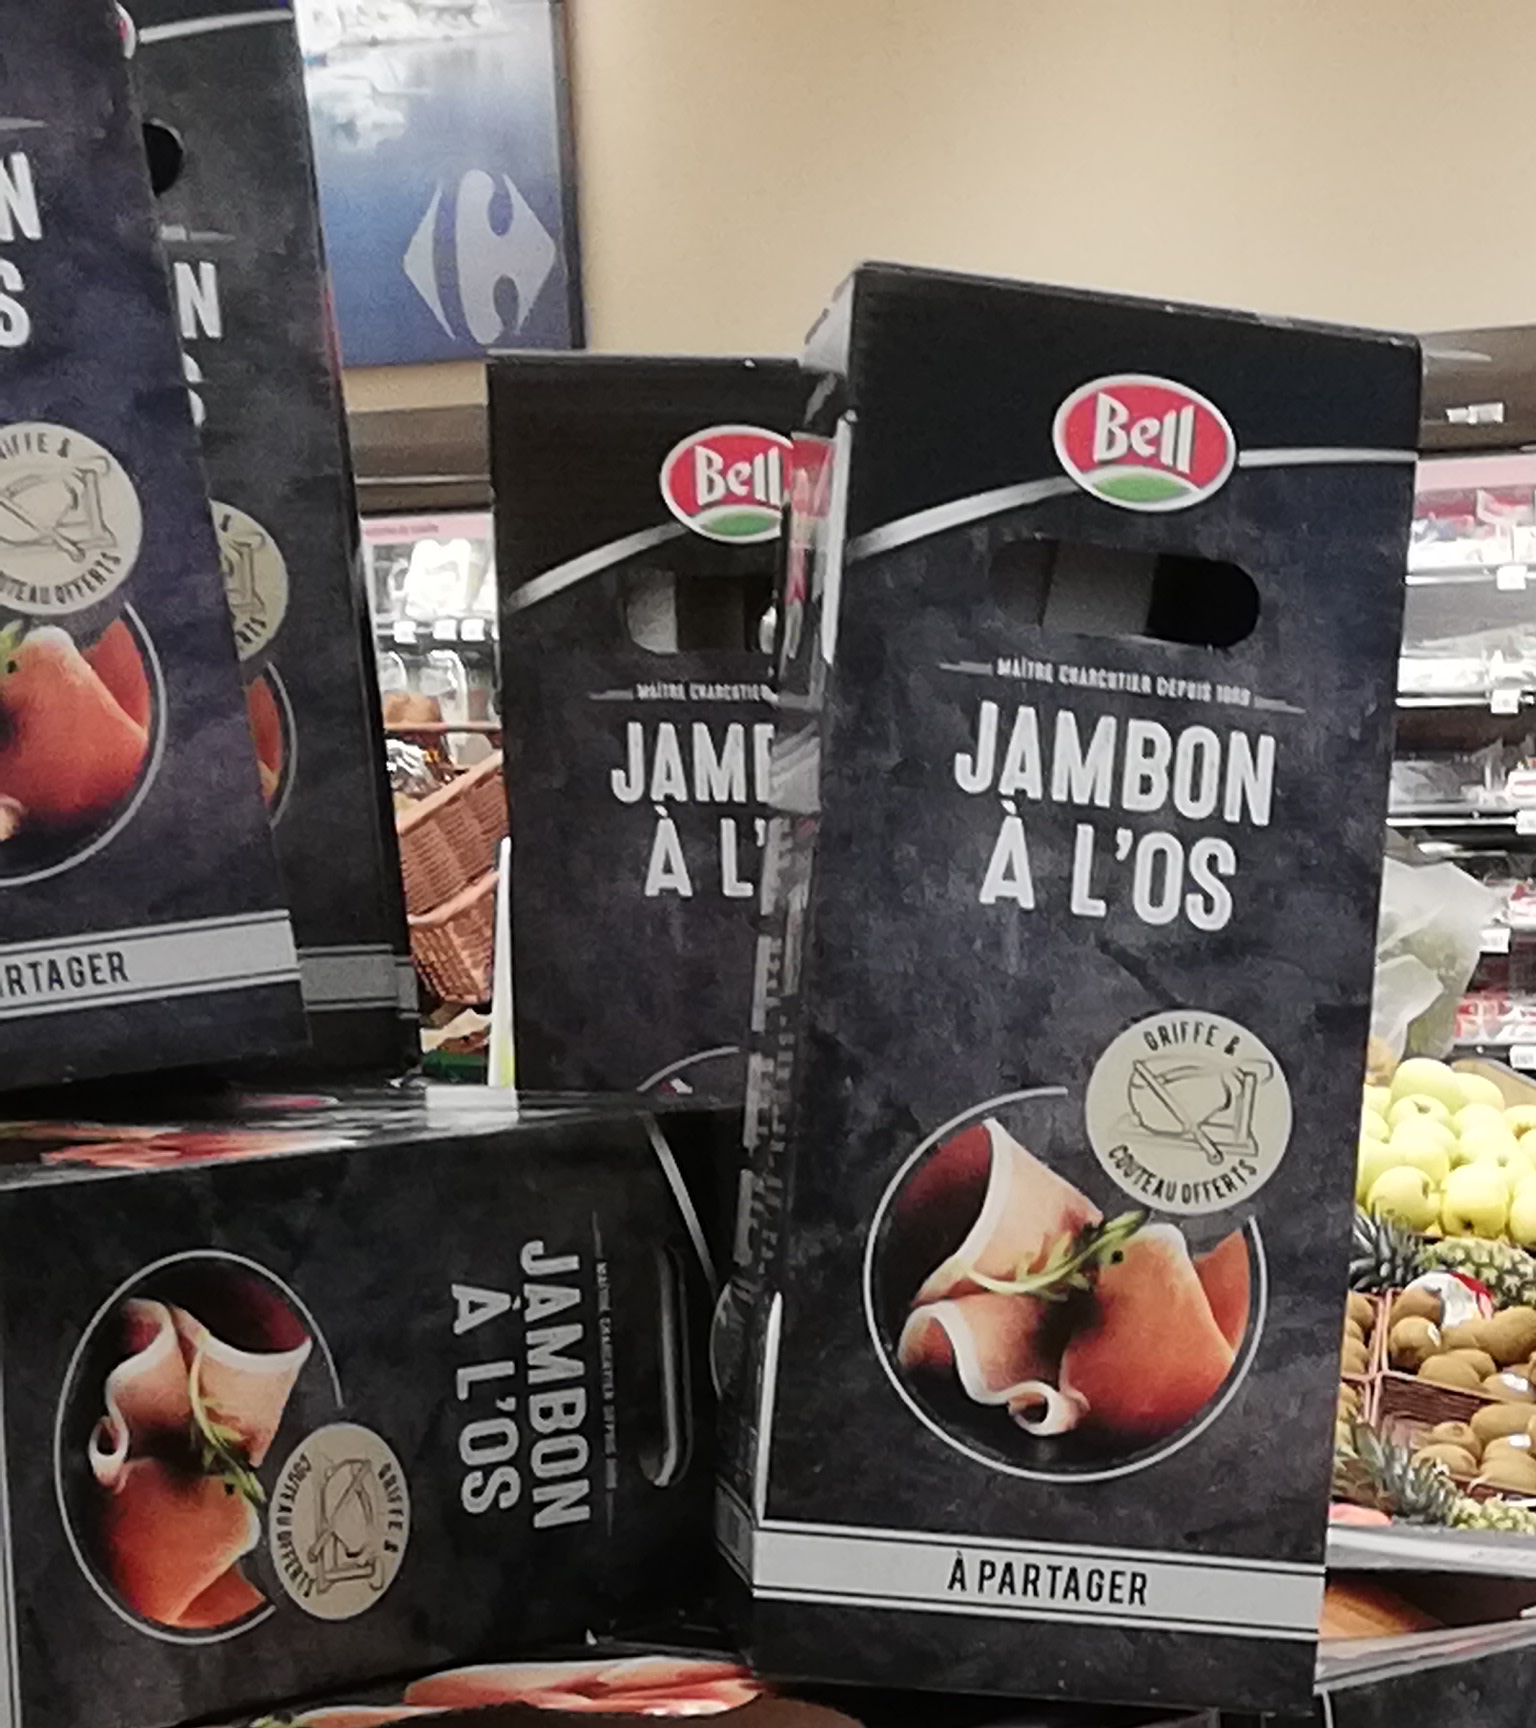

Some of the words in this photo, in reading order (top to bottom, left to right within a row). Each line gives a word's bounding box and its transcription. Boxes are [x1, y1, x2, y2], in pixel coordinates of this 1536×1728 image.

[1094, 391, 1196, 475] Bell
[693, 446, 783, 506] Bell
[954, 700, 1277, 827] JAMBON
[644, 804, 694, 898] À
[979, 798, 1036, 911] À
[1070, 822, 1238, 932] L'OS
[0, 950, 131, 997] RTAGER
[1223, 1035, 1242, 1056] &
[1180, 1158, 1259, 1205] OFFERTS
[519, 1240, 592, 1529] JAMBON
[946, 1550, 969, 1592] À
[976, 1558, 1151, 1607] PARTAGER
